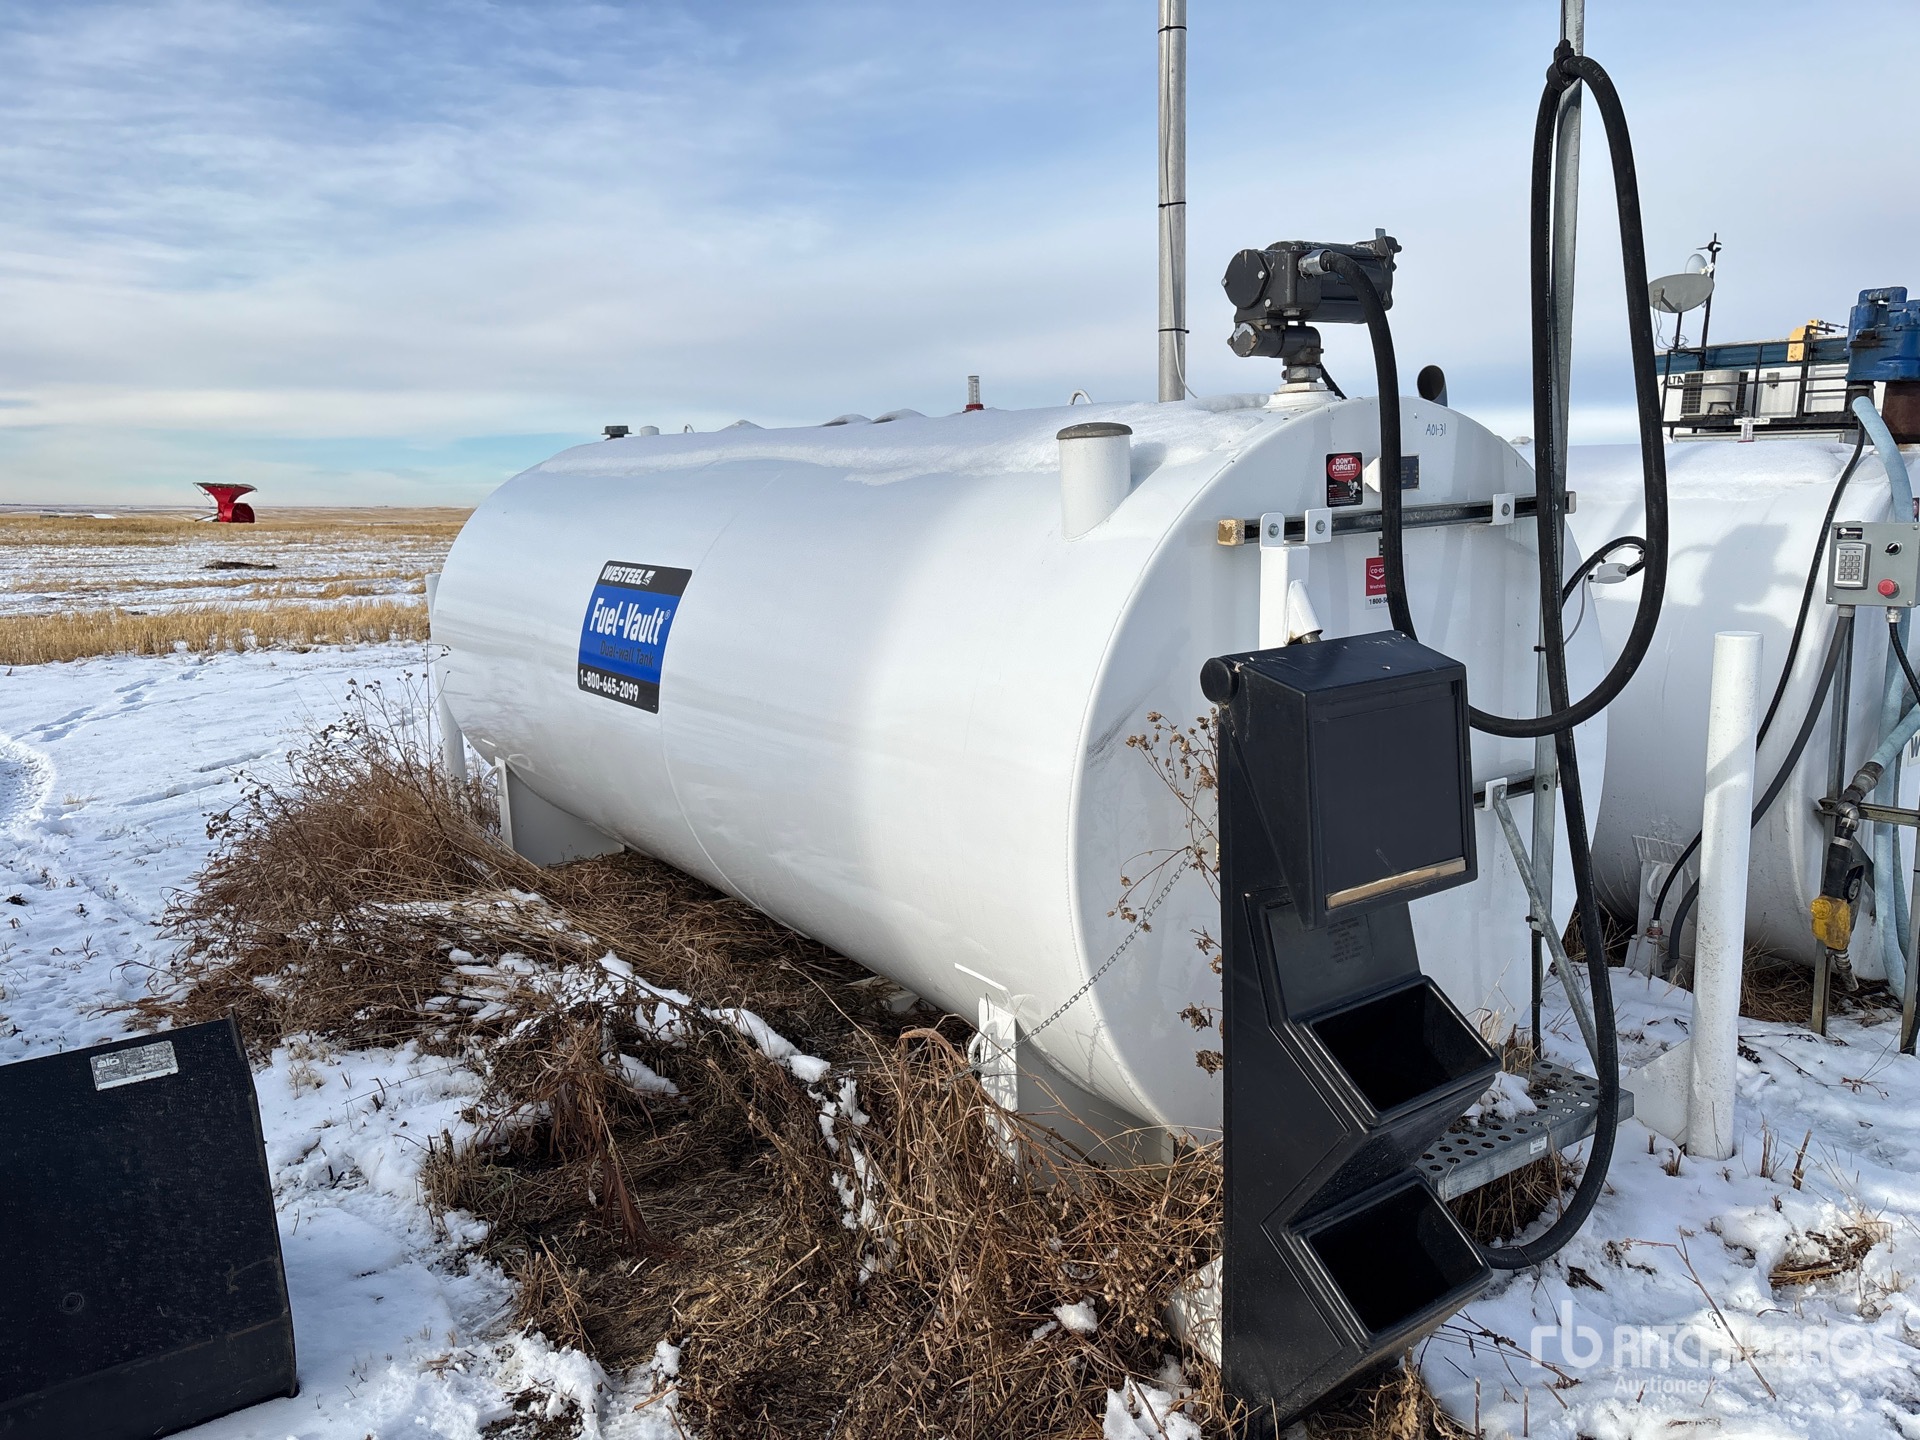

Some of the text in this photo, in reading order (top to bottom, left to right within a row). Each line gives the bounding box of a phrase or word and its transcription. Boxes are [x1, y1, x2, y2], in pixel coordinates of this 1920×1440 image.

[601, 565, 646, 585] WESTEEL
[600, 639, 654, 667] Dual-wall Tank
[580, 669, 639, 702] 1-800-665-2099
